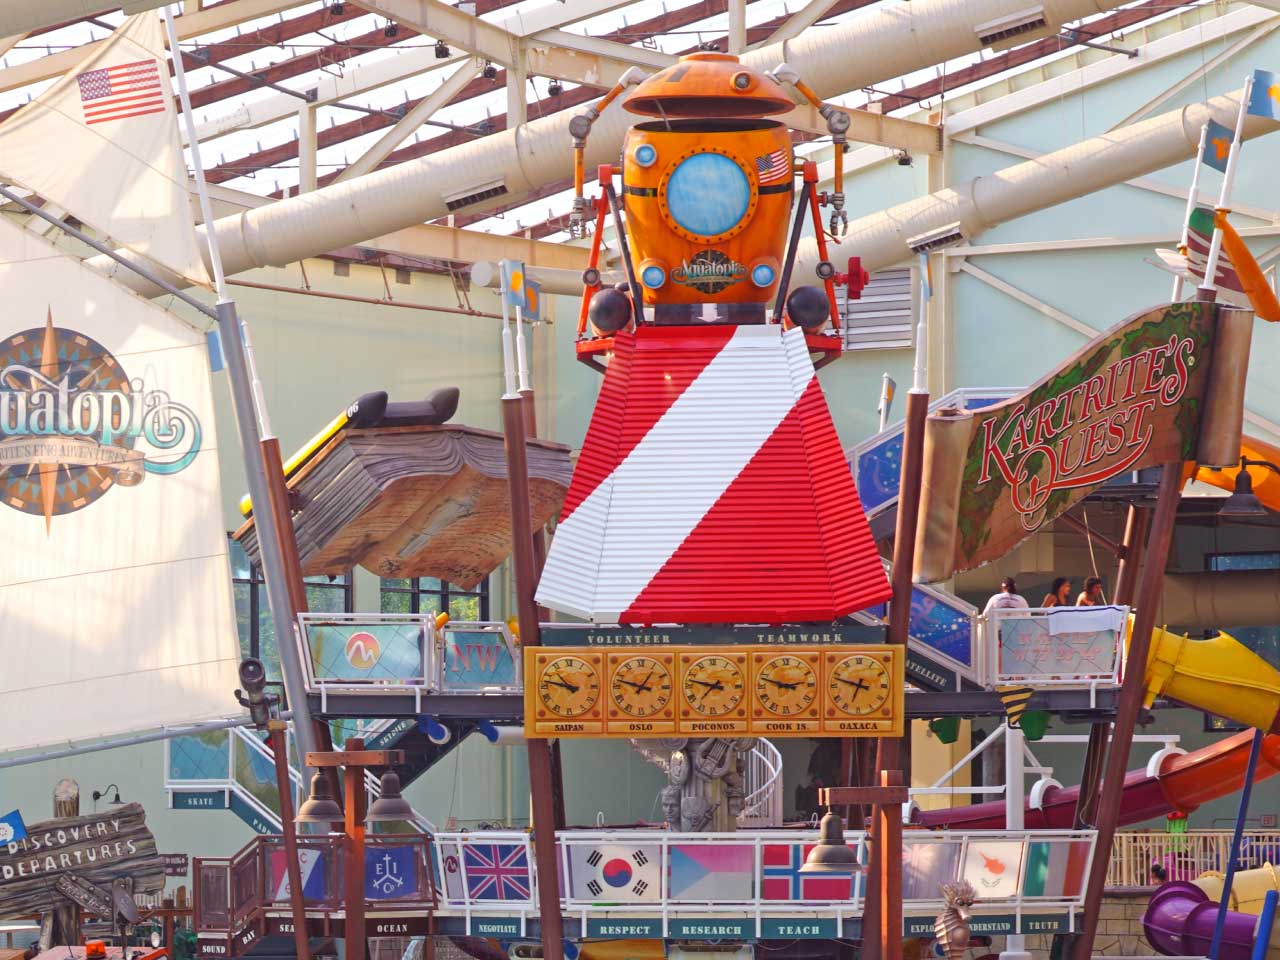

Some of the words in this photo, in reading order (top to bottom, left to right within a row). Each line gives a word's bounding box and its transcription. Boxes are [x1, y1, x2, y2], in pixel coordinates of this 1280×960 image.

[671, 257, 749, 284] Aquatopia
[978, 335, 1195, 485] KARTRITE'S
[1011, 399, 1155, 531] QUEST
[588, 635, 671, 644] VOLUNTEER
[757, 633, 843, 643] TEAMWORK
[451, 644, 502, 672] NW
[906, 660, 947, 687] ATELLITE
[554, 723, 584, 731] SAIPAN
[629, 723, 653, 731] OSLO
[839, 722, 878, 730] OAXACA
[188, 798, 213, 806] SKATE
[8, 819, 120, 854] DISCOVERY
[2, 840, 136, 879] DEPARTURES
[377, 924, 408, 933] OCEAN
[478, 924, 517, 934] NEGOTIATE
[911, 924, 935, 933] EXPLO
[968, 922, 1011, 932] NDERSTAND
[1029, 921, 1059, 930] TRUTH
[600, 926, 651, 935] RESPECT
[682, 926, 742, 935] RESEARCH
[778, 926, 820, 935] TEACH
[242, 930, 256, 945] BAY
[202, 945, 226, 954] SOUND
